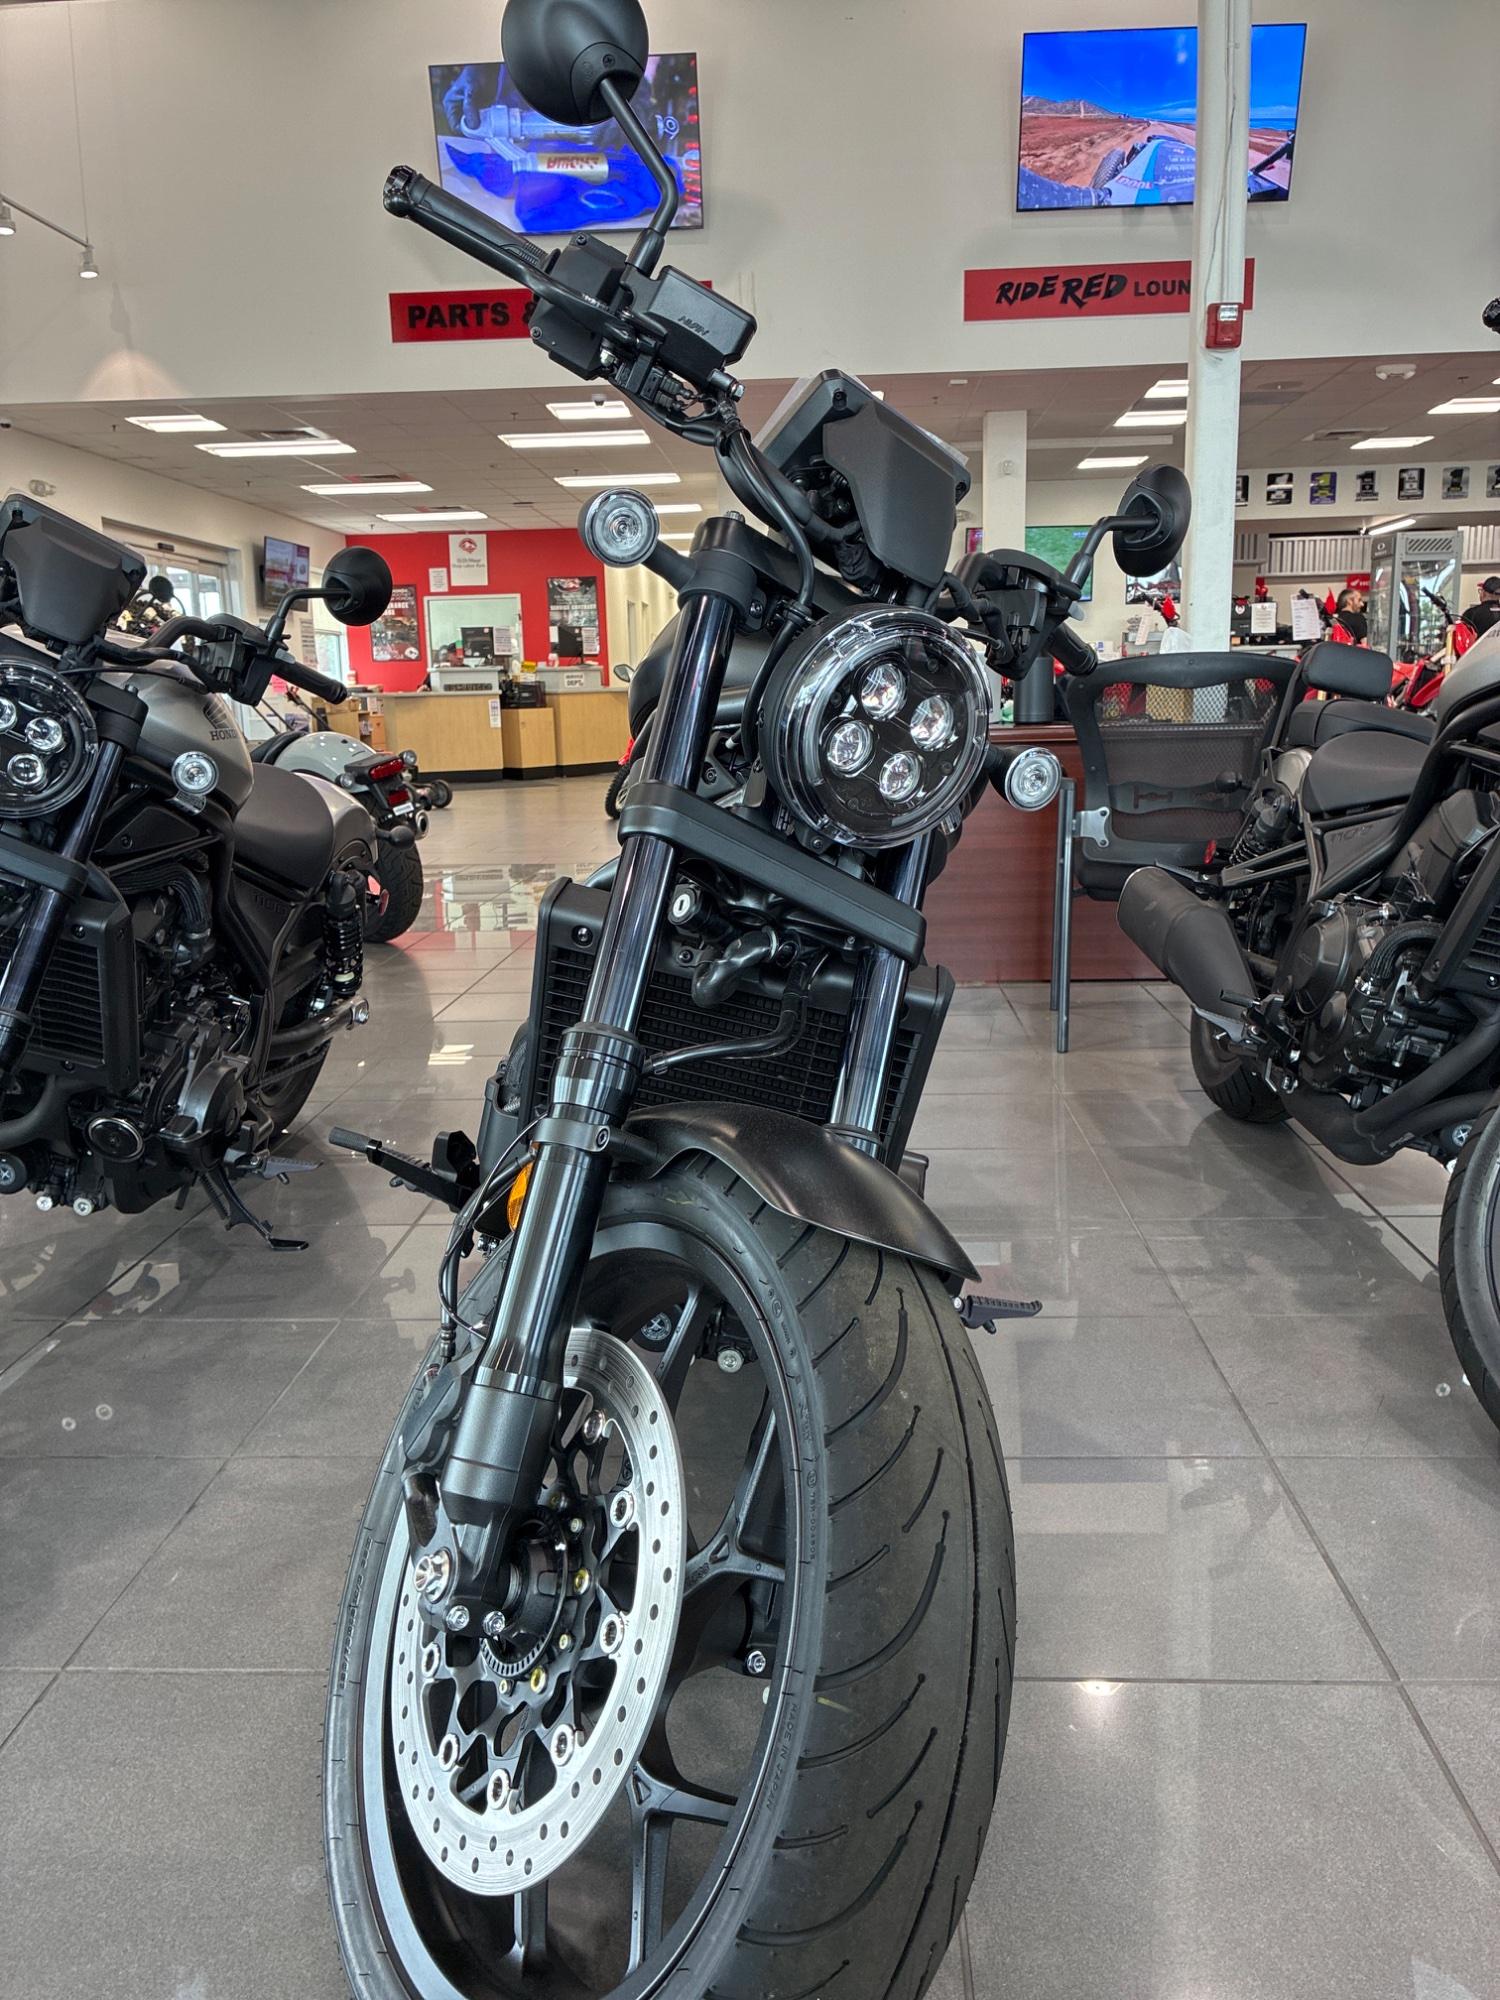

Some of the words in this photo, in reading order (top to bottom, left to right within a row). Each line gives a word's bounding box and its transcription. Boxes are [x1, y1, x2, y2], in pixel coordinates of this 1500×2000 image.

[995, 274, 1059, 306] RIDE
[1060, 272, 1128, 309] RED
[1134, 279, 1191, 297] LOUN
[407, 302, 510, 329] PARTS
[209, 728, 238, 741] HOND
[784, 1702, 799, 1740] MADE
[779, 1743, 791, 1760] IN
[766, 1763, 785, 1811] JAPAN
